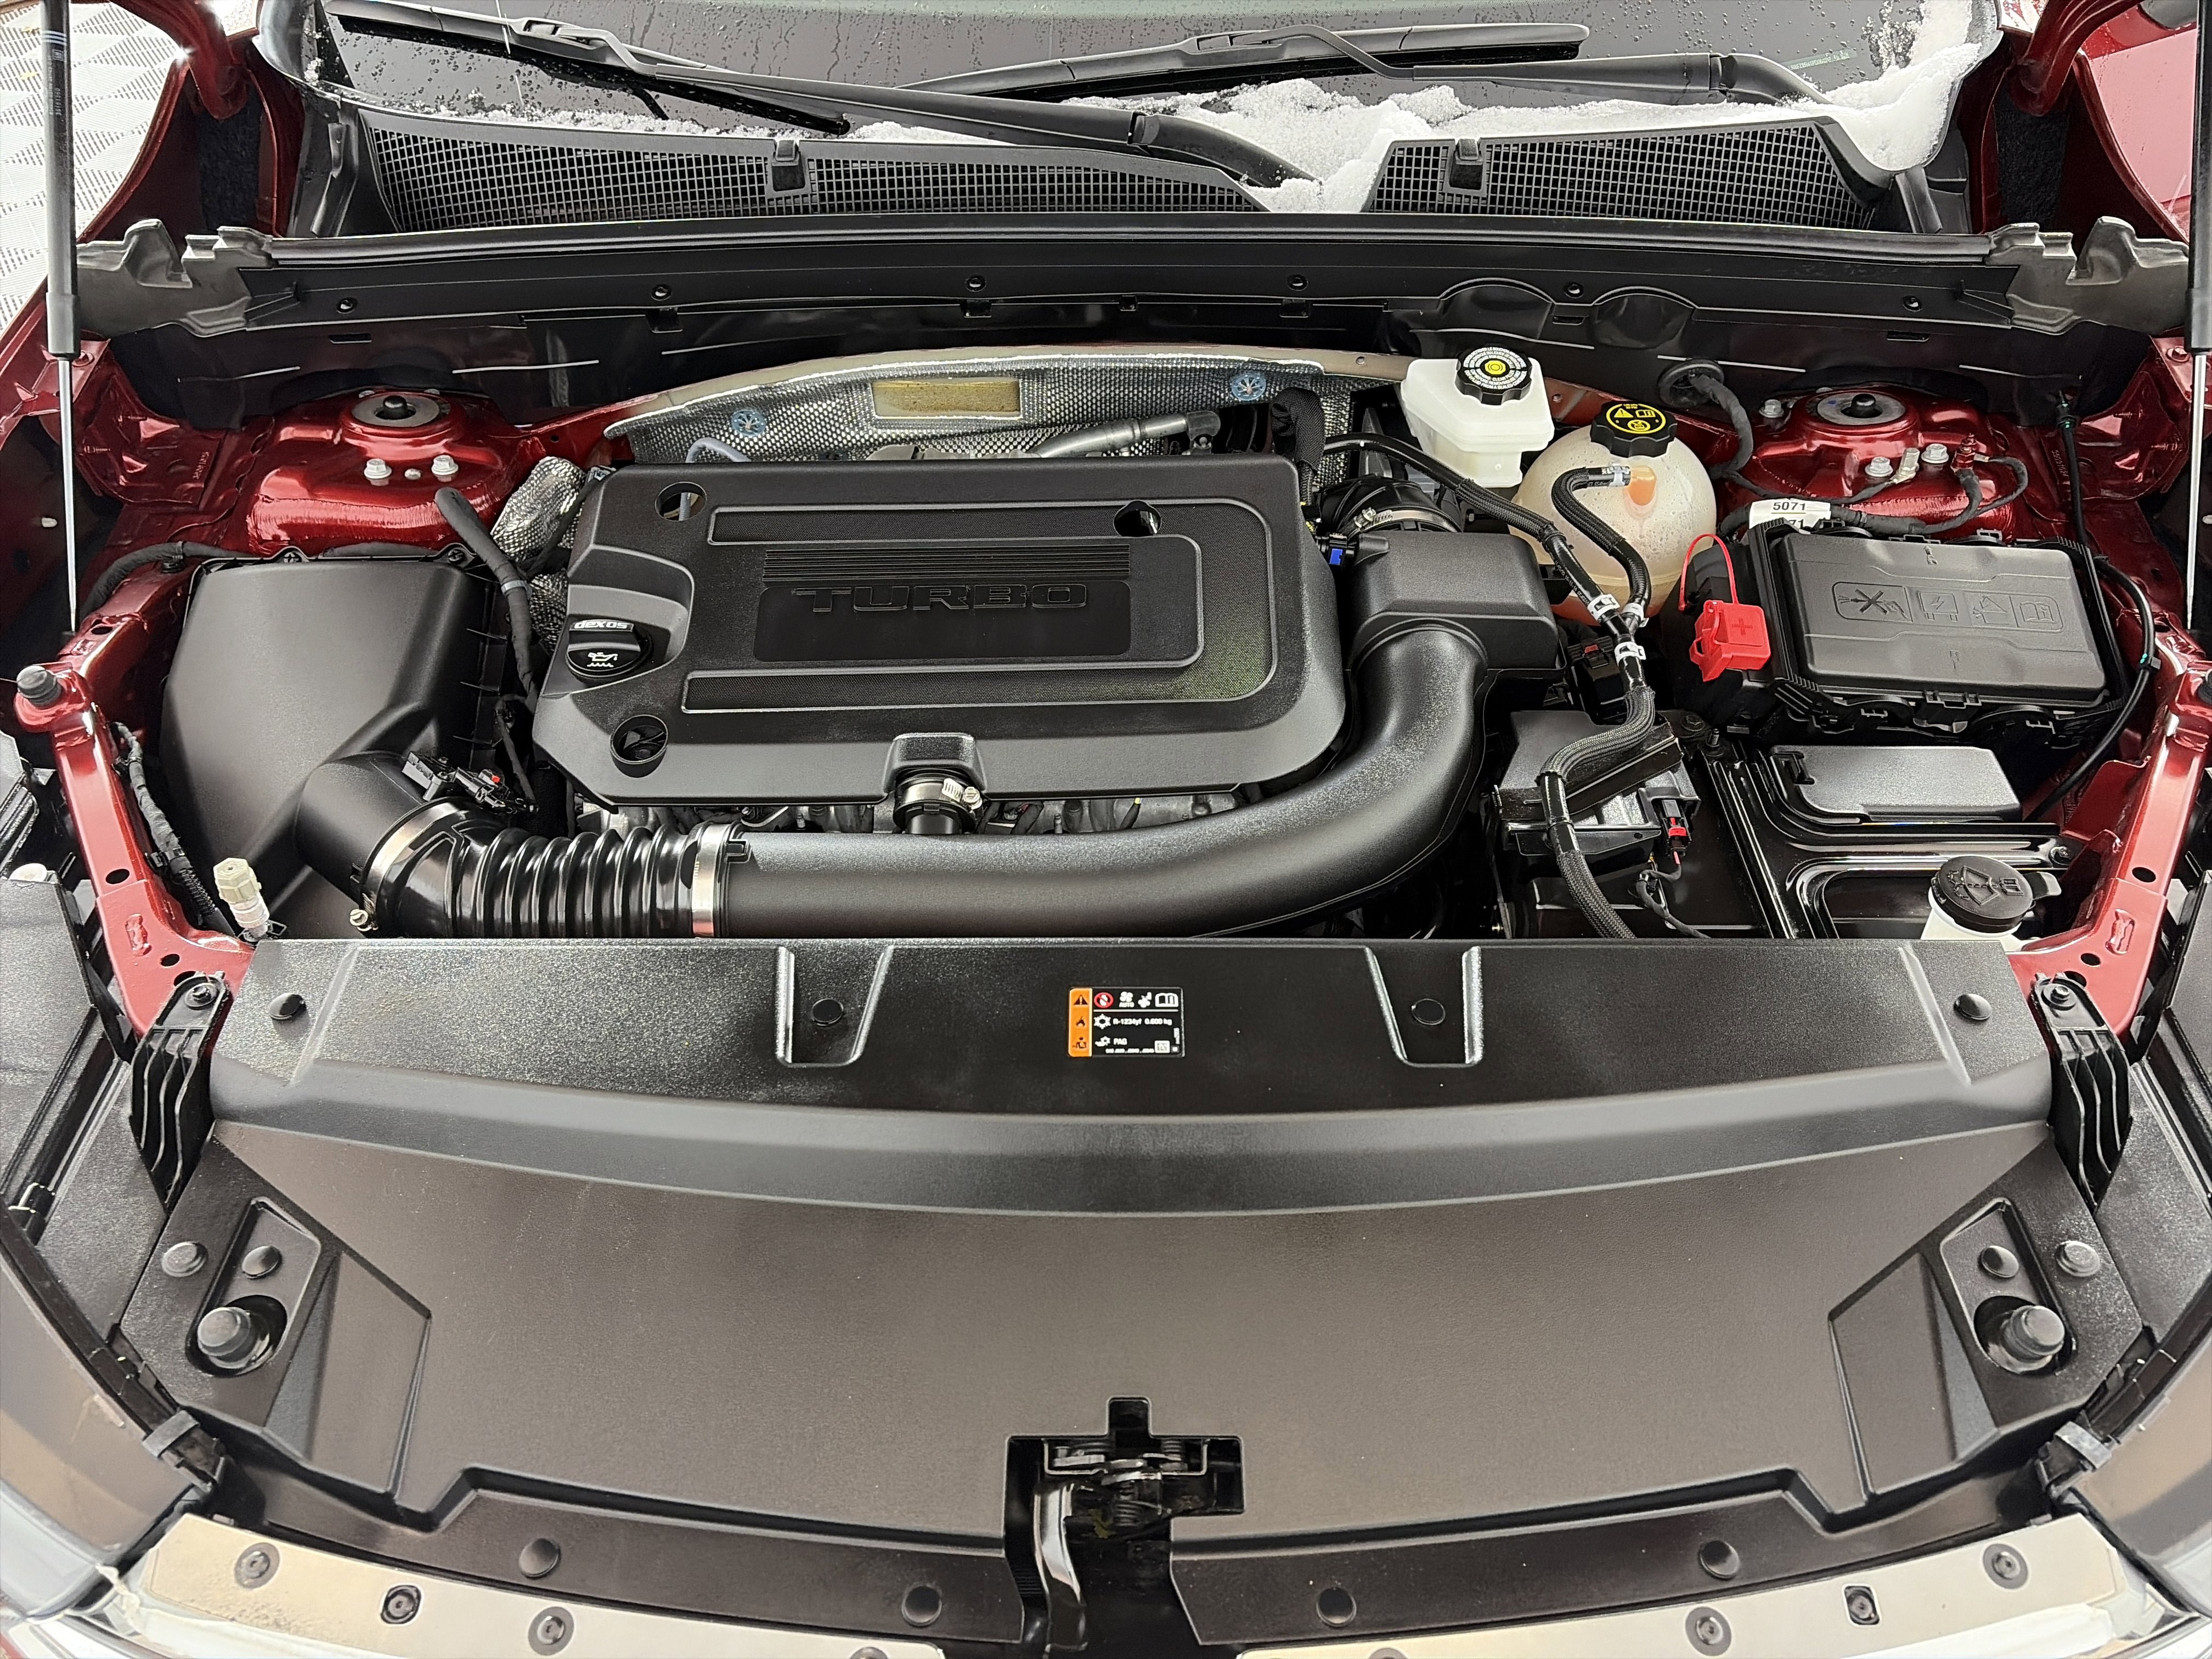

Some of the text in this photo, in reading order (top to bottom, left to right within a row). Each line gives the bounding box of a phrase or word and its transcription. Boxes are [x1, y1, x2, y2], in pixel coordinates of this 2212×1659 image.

[1773, 502, 1805, 510] 5071
[792, 584, 1087, 612] TURBO
[574, 620, 628, 629] dexos
